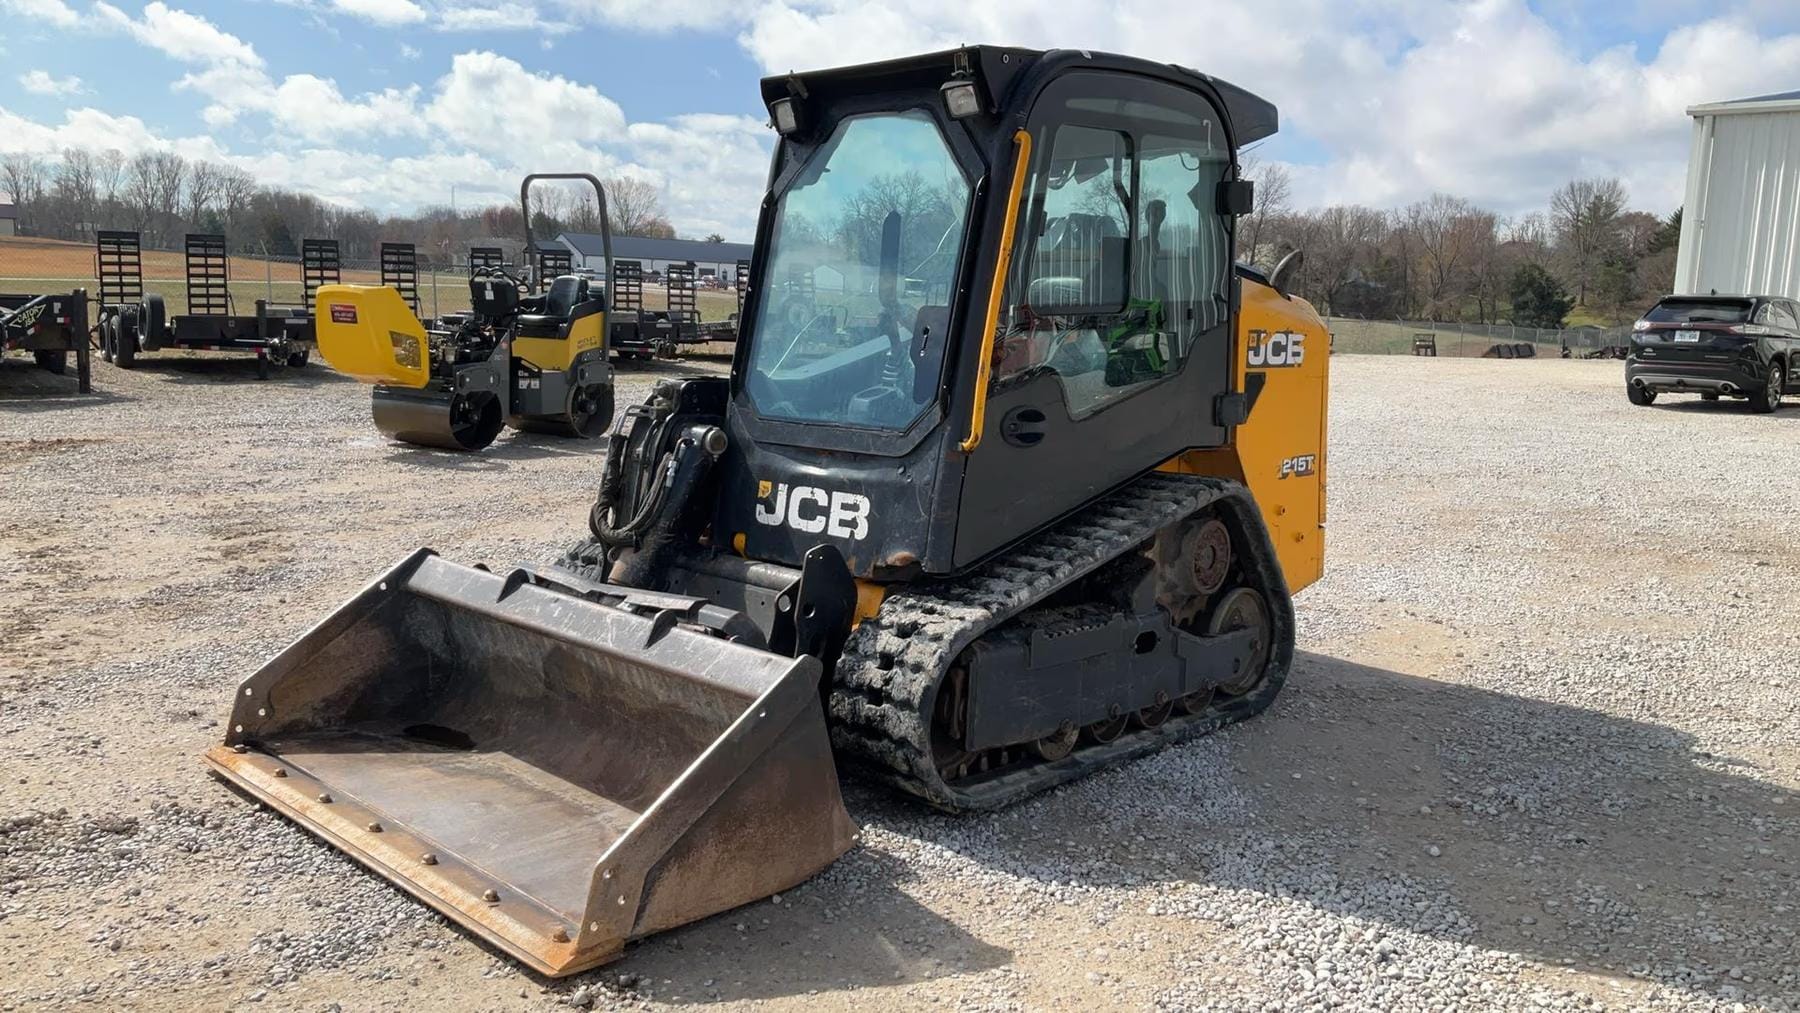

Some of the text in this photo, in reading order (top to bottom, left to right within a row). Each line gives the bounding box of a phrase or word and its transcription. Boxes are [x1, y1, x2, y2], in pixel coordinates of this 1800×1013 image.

[1248, 333, 1305, 365] JCB
[1282, 455, 1314, 473] 215T
[755, 481, 870, 540] JCB
